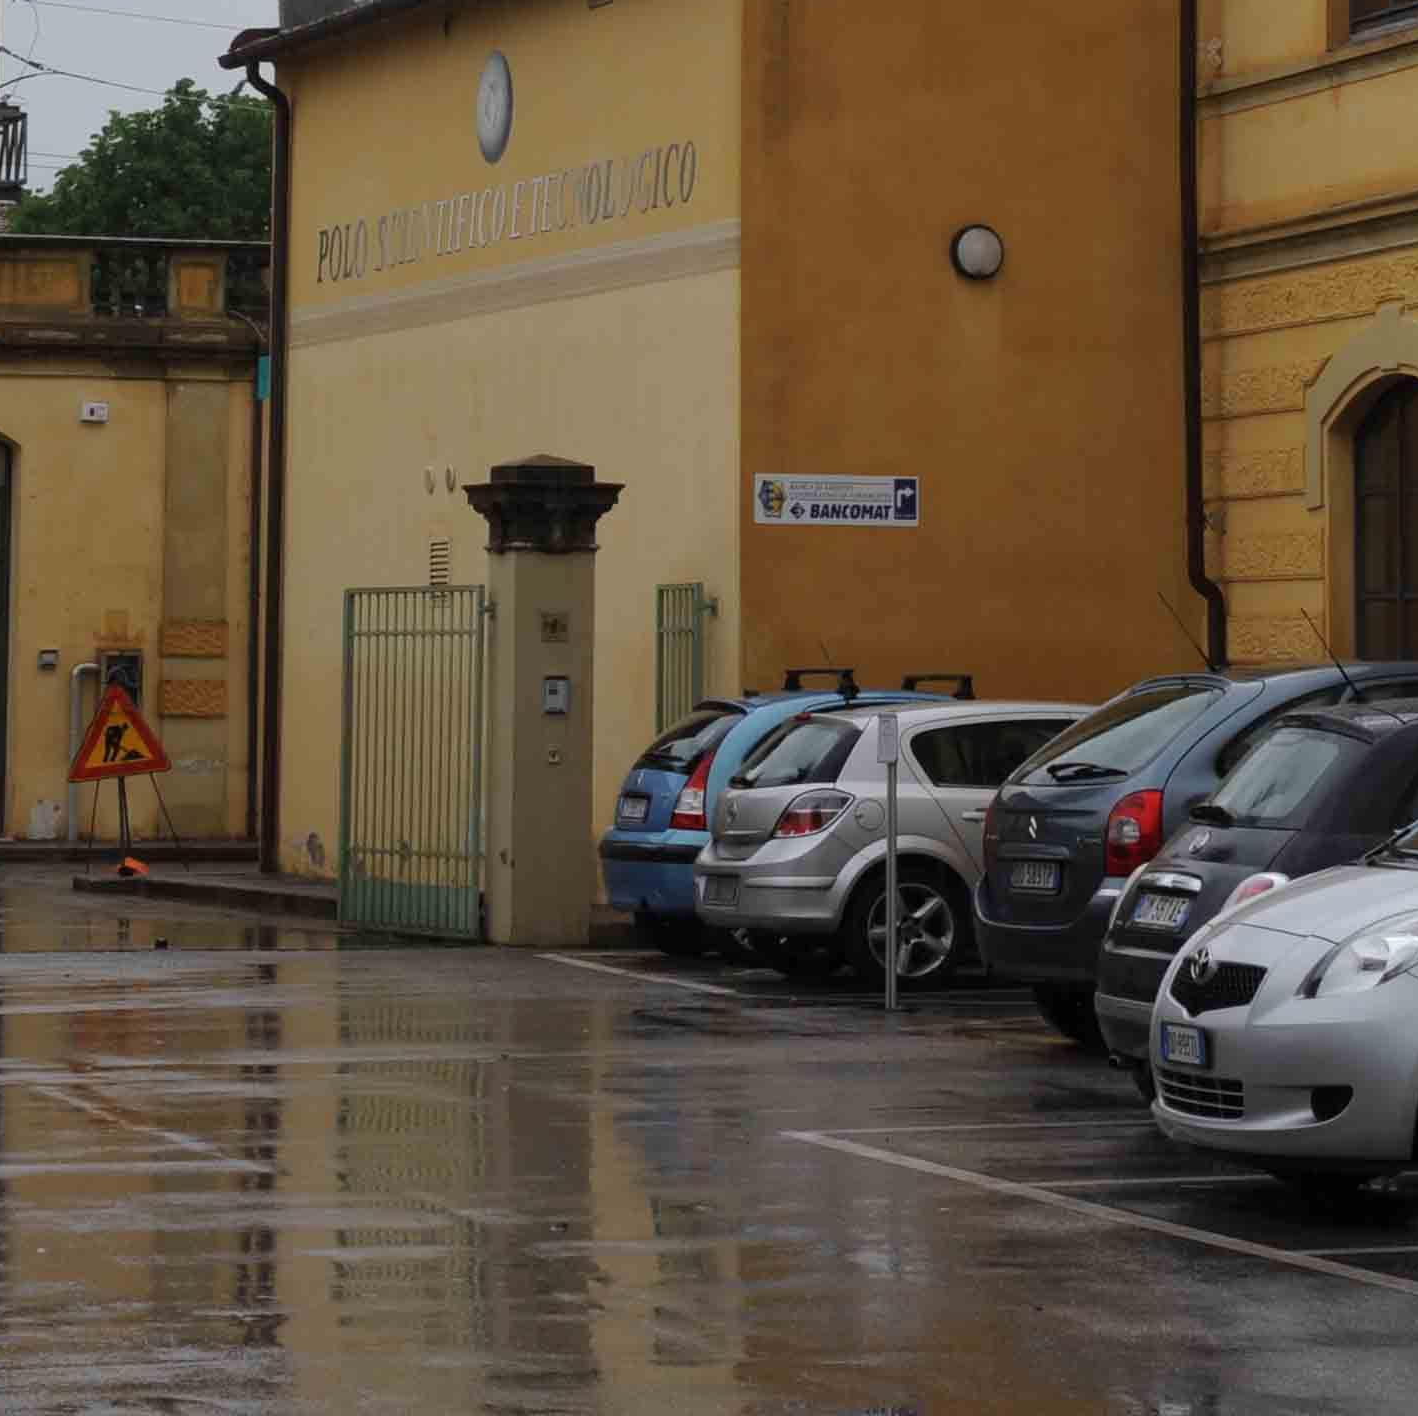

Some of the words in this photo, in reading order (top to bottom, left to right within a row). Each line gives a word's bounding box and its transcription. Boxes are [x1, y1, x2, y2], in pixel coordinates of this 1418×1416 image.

[317, 221, 366, 284] POLO
[373, 184, 507, 272] SCIENTIFICO
[510, 182, 525, 240] E
[528, 140, 697, 237] TECNOLOGICO
[810, 504, 892, 520] BANCOMAT
